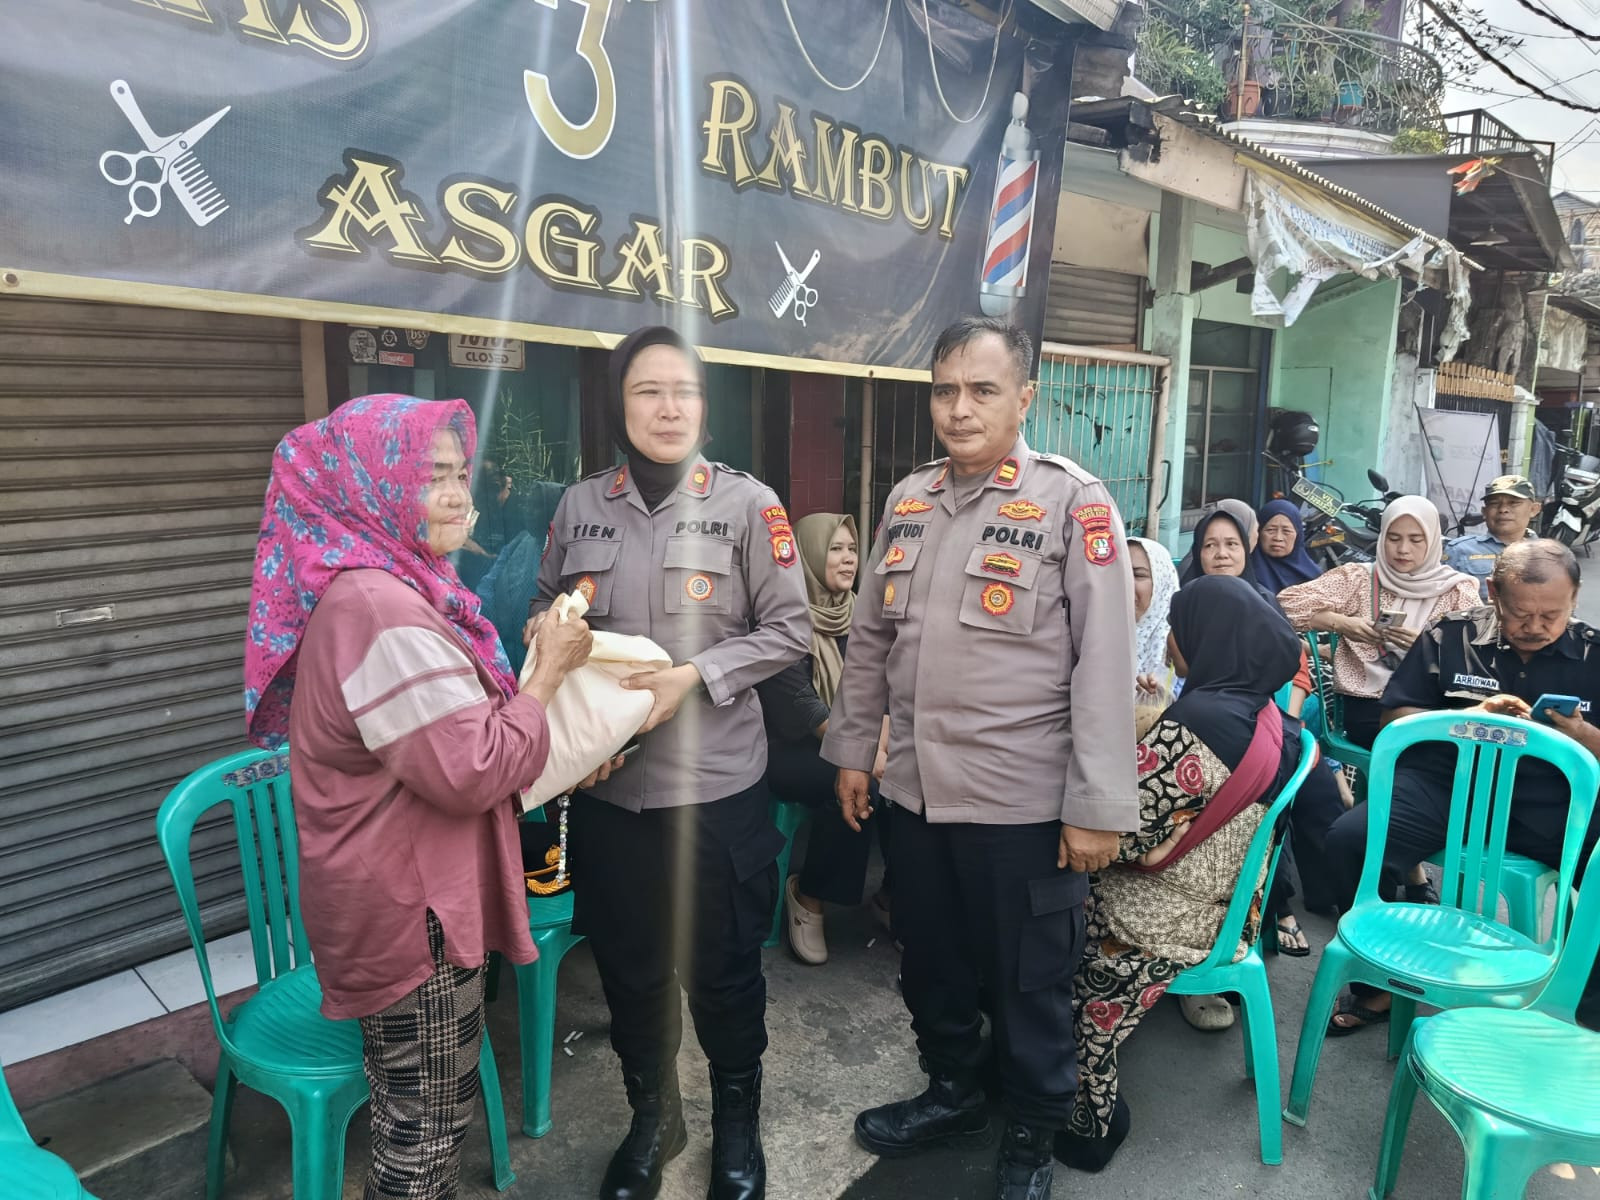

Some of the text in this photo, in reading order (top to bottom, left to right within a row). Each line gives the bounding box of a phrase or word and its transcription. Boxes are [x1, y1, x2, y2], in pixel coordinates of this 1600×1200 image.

[524, 0, 617, 159] 3
[702, 79, 970, 239] RAMBUT
[305, 158, 736, 318] ASGAR
[465, 352, 509, 364] CLOSED
[573, 524, 616, 539] TIEN
[676, 519, 729, 537] POLRI
[982, 526, 1045, 550] POLRI
